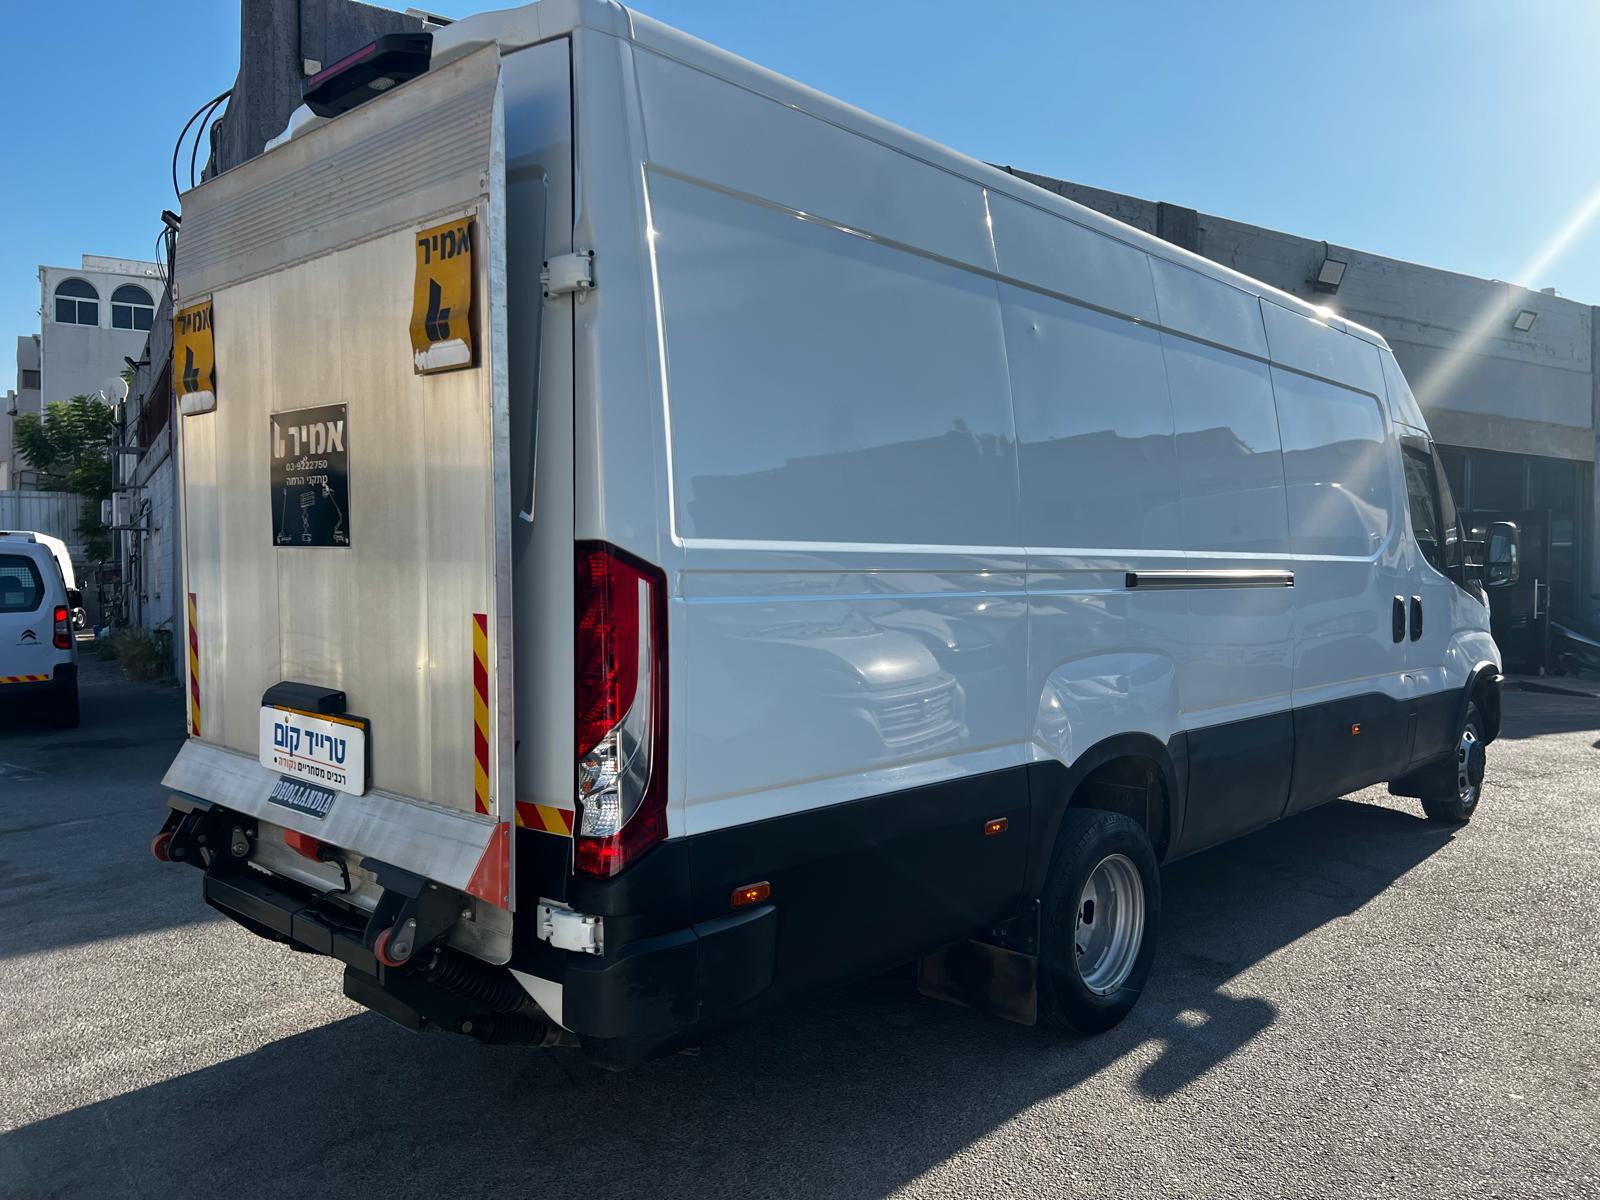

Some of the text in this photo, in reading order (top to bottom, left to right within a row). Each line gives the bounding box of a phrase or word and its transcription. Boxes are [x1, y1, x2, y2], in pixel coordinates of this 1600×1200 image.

[418, 226, 470, 265] אמיר
[176, 307, 211, 335] אמיר
[287, 420, 345, 456] אמיר
[285, 459, 328, 472] 03-9222750
[285, 474, 328, 487] מתקני הרמה
[304, 729, 346, 764] טרייד
[297, 762, 325, 779] מסחריים
[326, 771, 346, 785] רכבים
[271, 780, 333, 813] DHOLLANDIA
